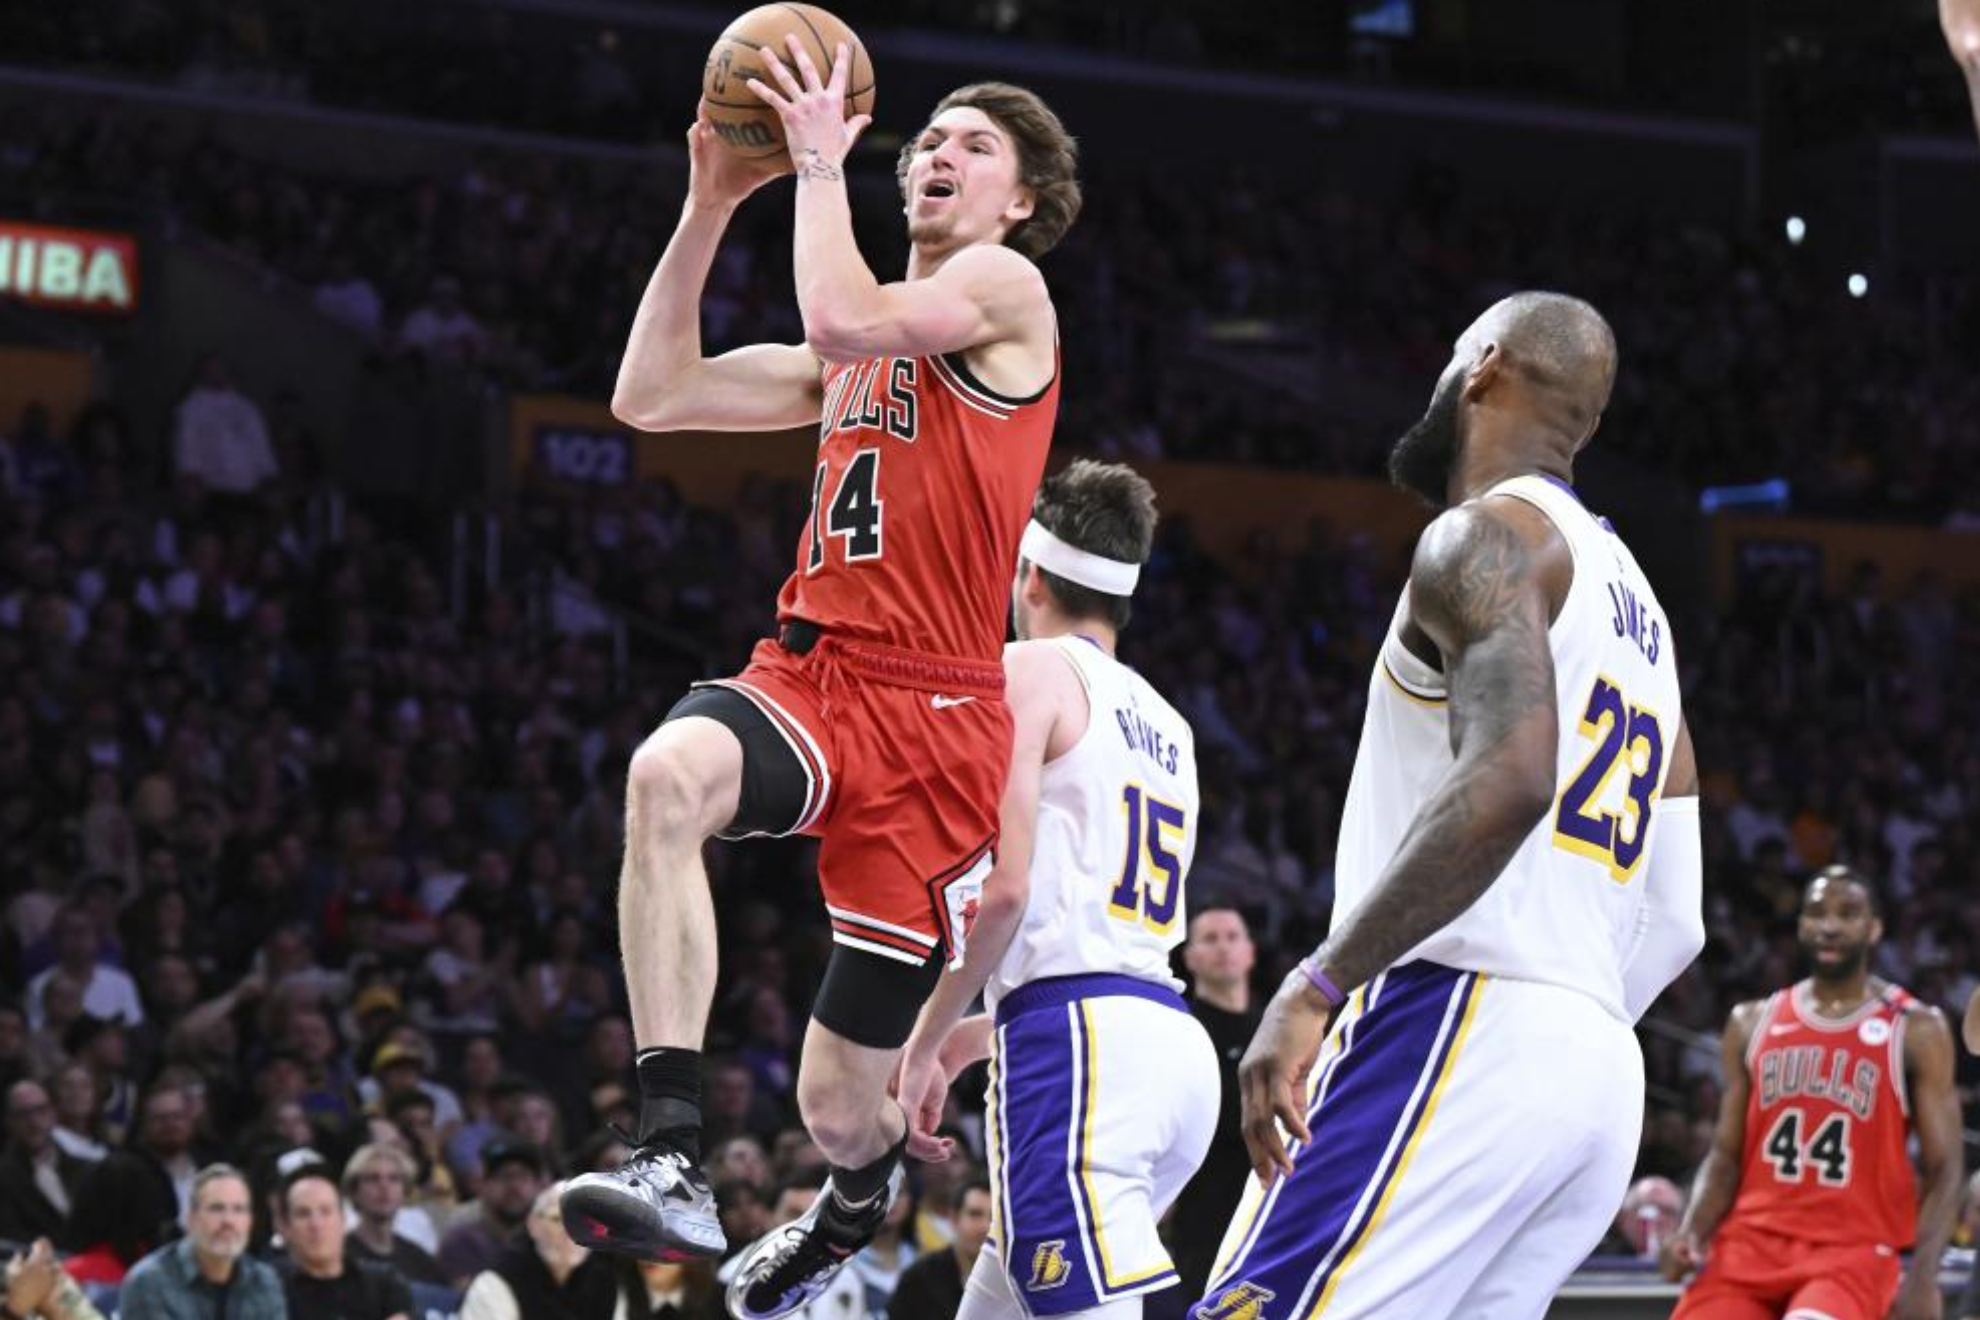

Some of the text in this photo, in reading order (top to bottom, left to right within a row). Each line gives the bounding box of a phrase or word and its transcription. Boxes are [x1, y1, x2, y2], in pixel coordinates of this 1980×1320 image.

[806, 448, 883, 575] 14
[1551, 672, 1663, 884] 23
[1107, 780, 1186, 936] 15
[1759, 1045, 1881, 1121] BULLS
[1762, 1106, 1854, 1189] 44
